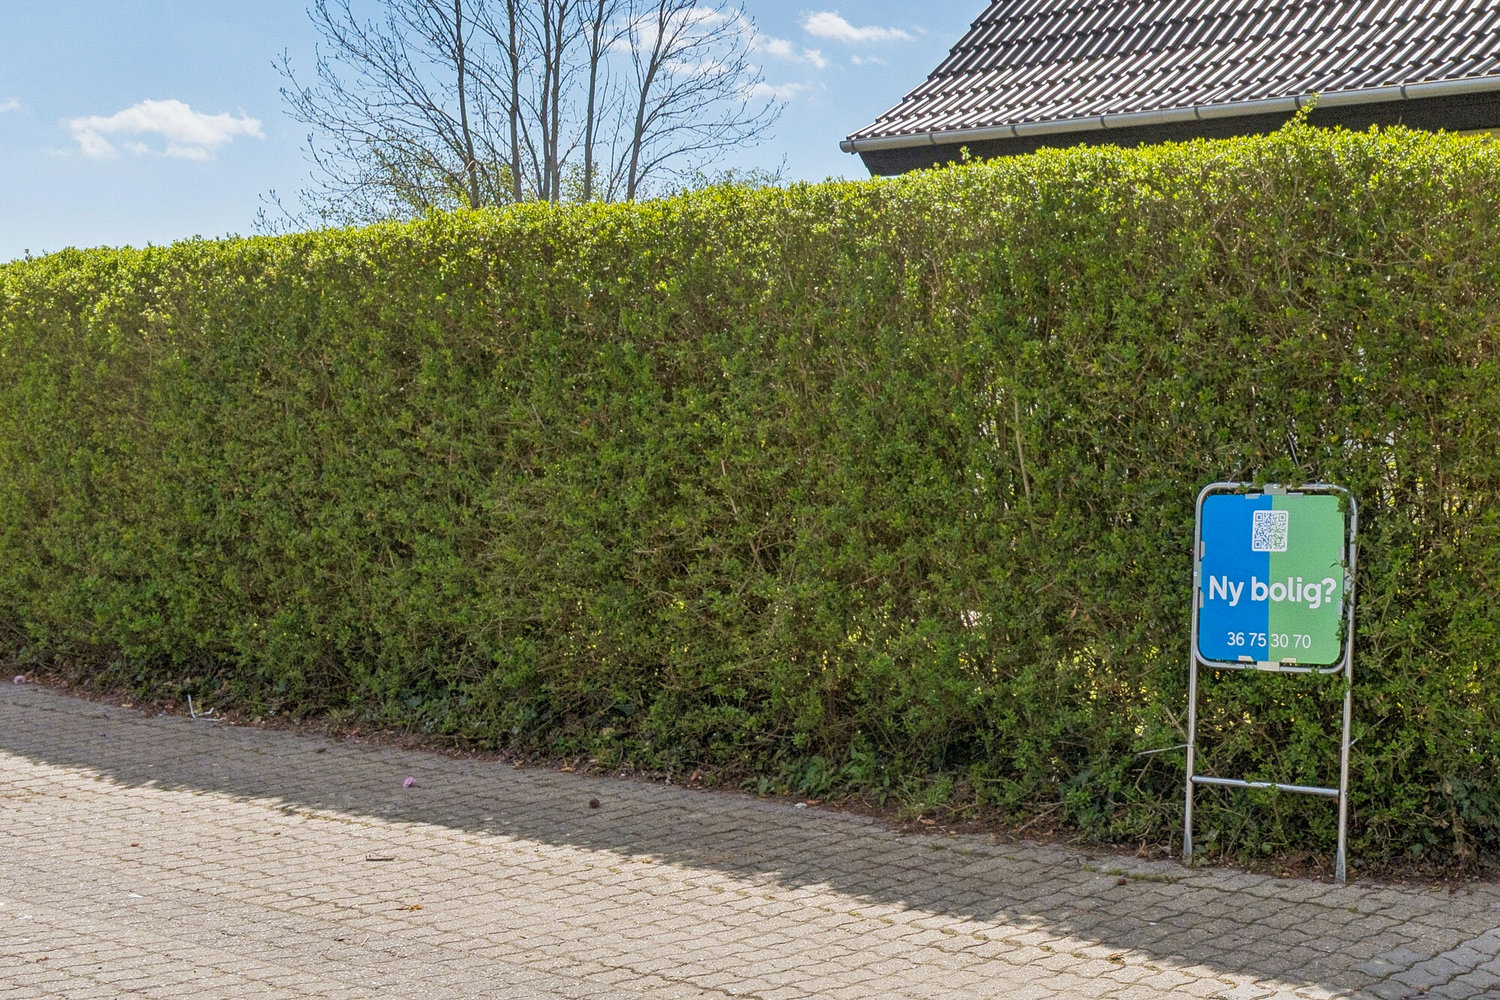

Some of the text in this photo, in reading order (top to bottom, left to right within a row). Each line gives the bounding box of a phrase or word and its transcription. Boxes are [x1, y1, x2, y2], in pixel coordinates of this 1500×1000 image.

[1209, 576, 1337, 609] Ny bolig?
[1227, 632, 1311, 649] 36 75 30 70
